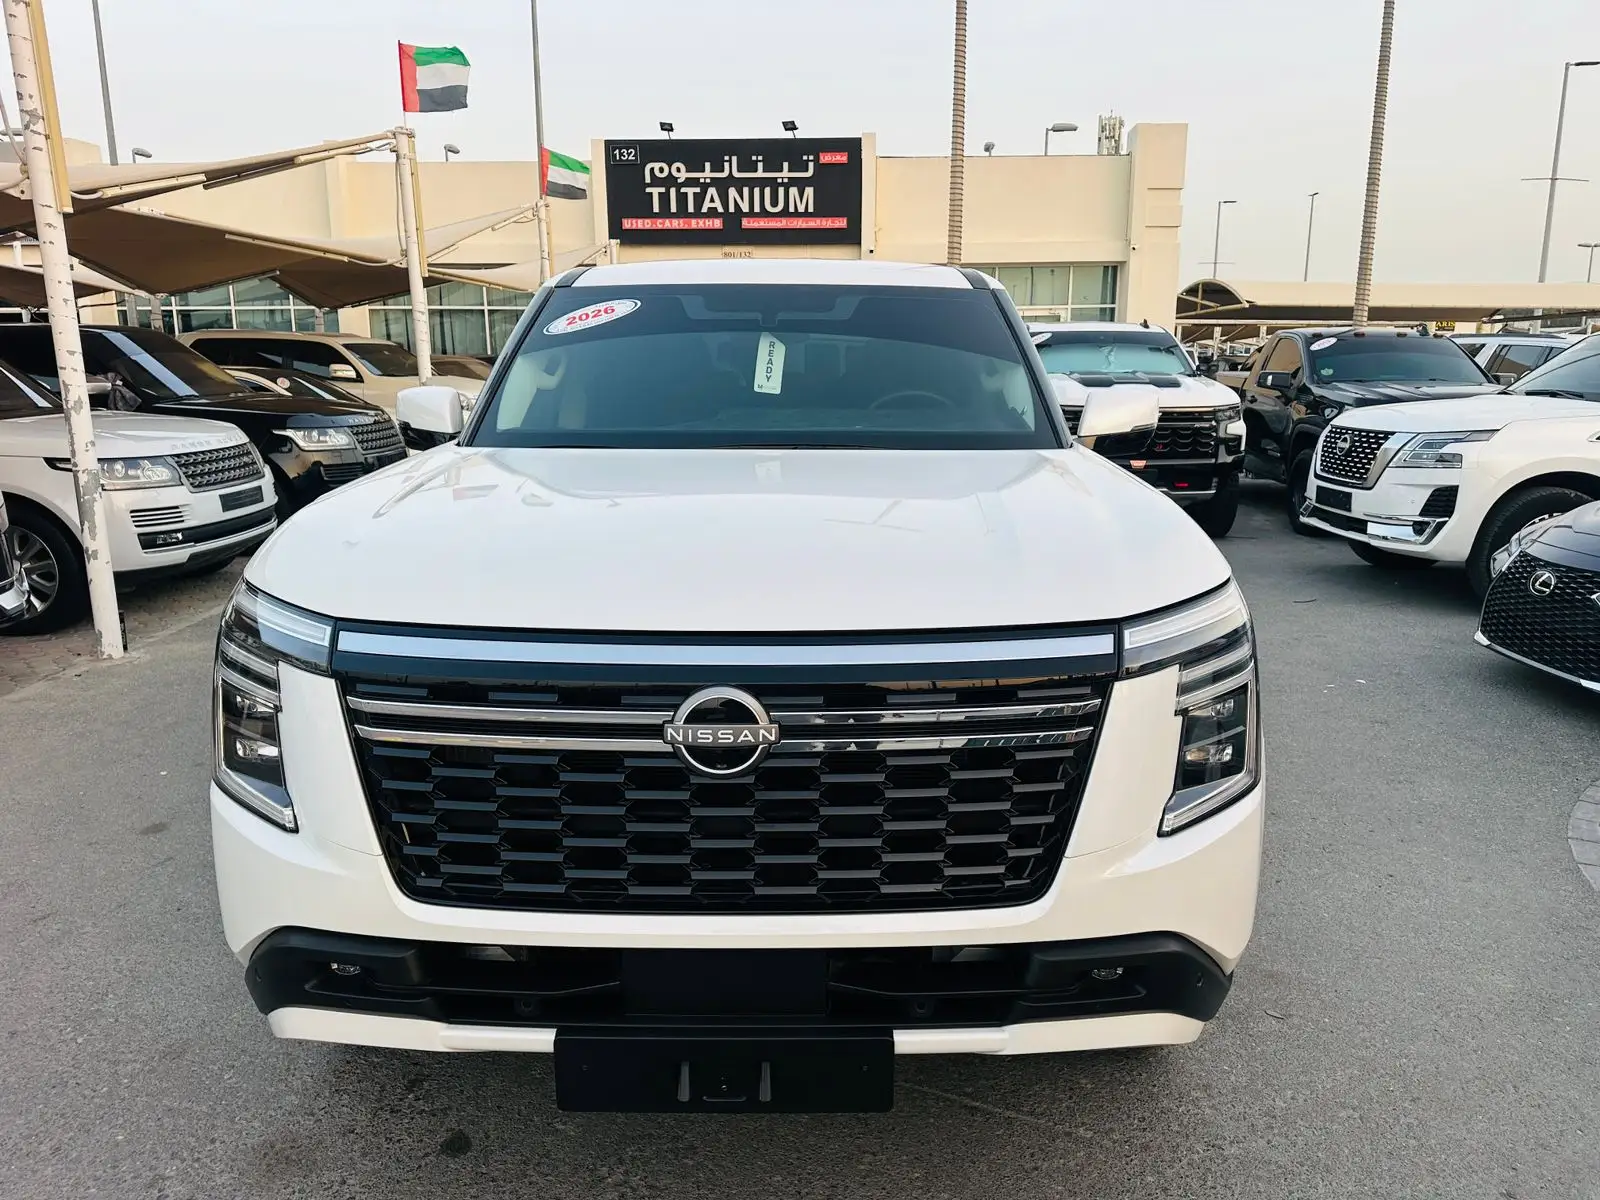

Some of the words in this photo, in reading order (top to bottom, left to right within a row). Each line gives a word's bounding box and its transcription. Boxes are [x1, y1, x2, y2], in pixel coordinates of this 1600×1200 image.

[613, 148, 636, 160] 132
[820, 153, 847, 163] معرض
[644, 155, 814, 183] تيتانيوم
[645, 186, 814, 213] TITANIUM
[690, 218, 722, 228] EXHB
[565, 305, 616, 326] 2026
[765, 341, 776, 383] READY
[667, 727, 776, 743] NISSAN
